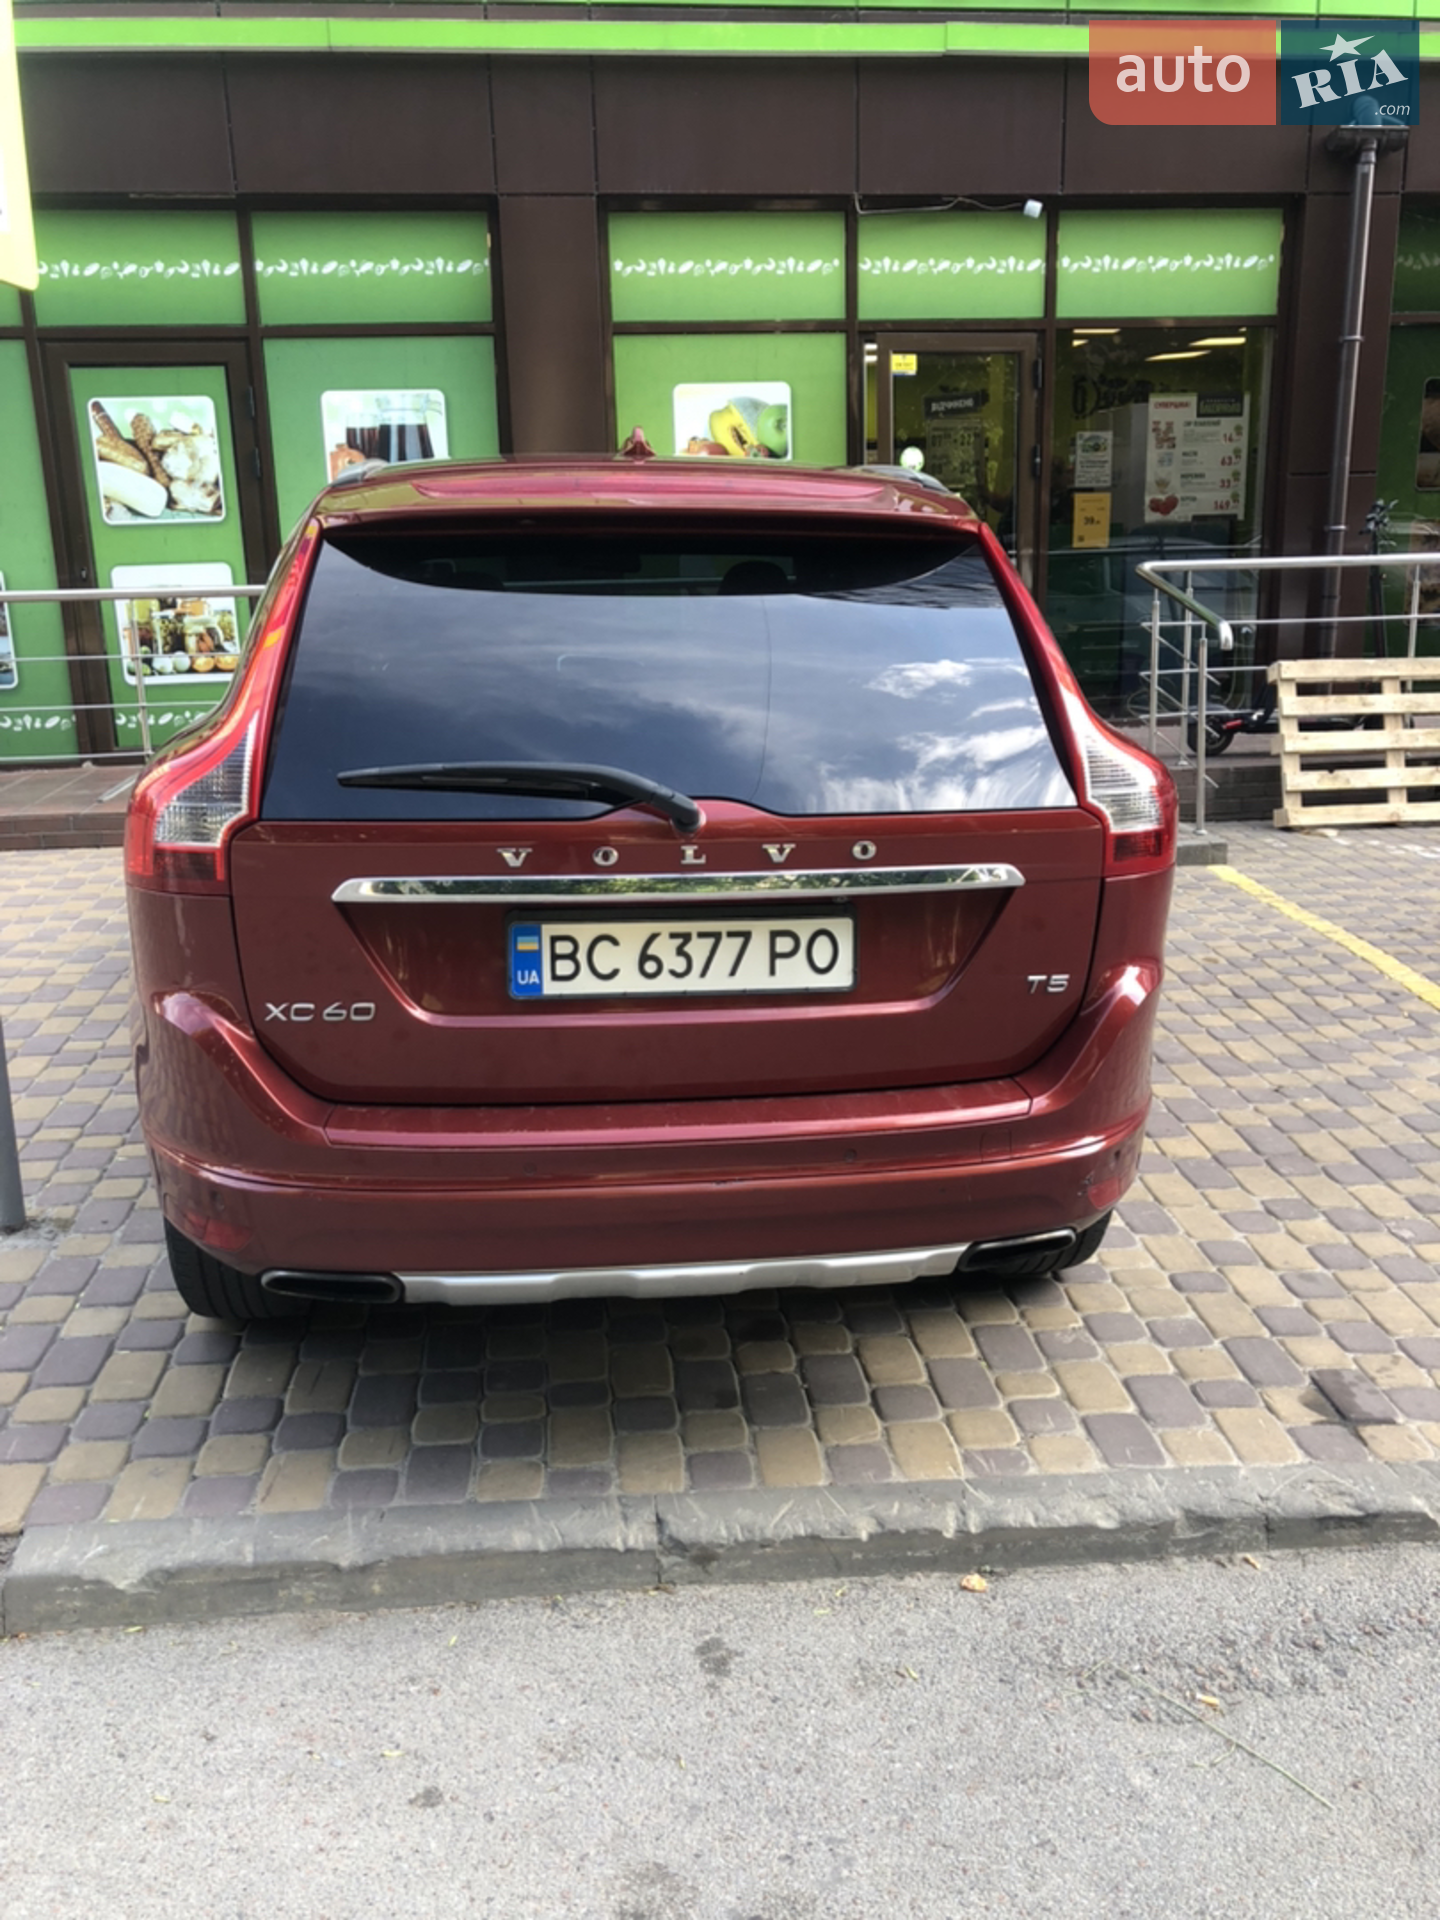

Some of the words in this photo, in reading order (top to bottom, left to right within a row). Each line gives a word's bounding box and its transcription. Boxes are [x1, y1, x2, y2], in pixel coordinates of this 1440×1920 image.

[497, 840, 878, 868] VOLVO
[549, 933, 621, 982] BC
[637, 931, 753, 980] 6377
[768, 928, 840, 977] PO
[517, 970, 541, 985] UA
[1027, 974, 1070, 994] T5
